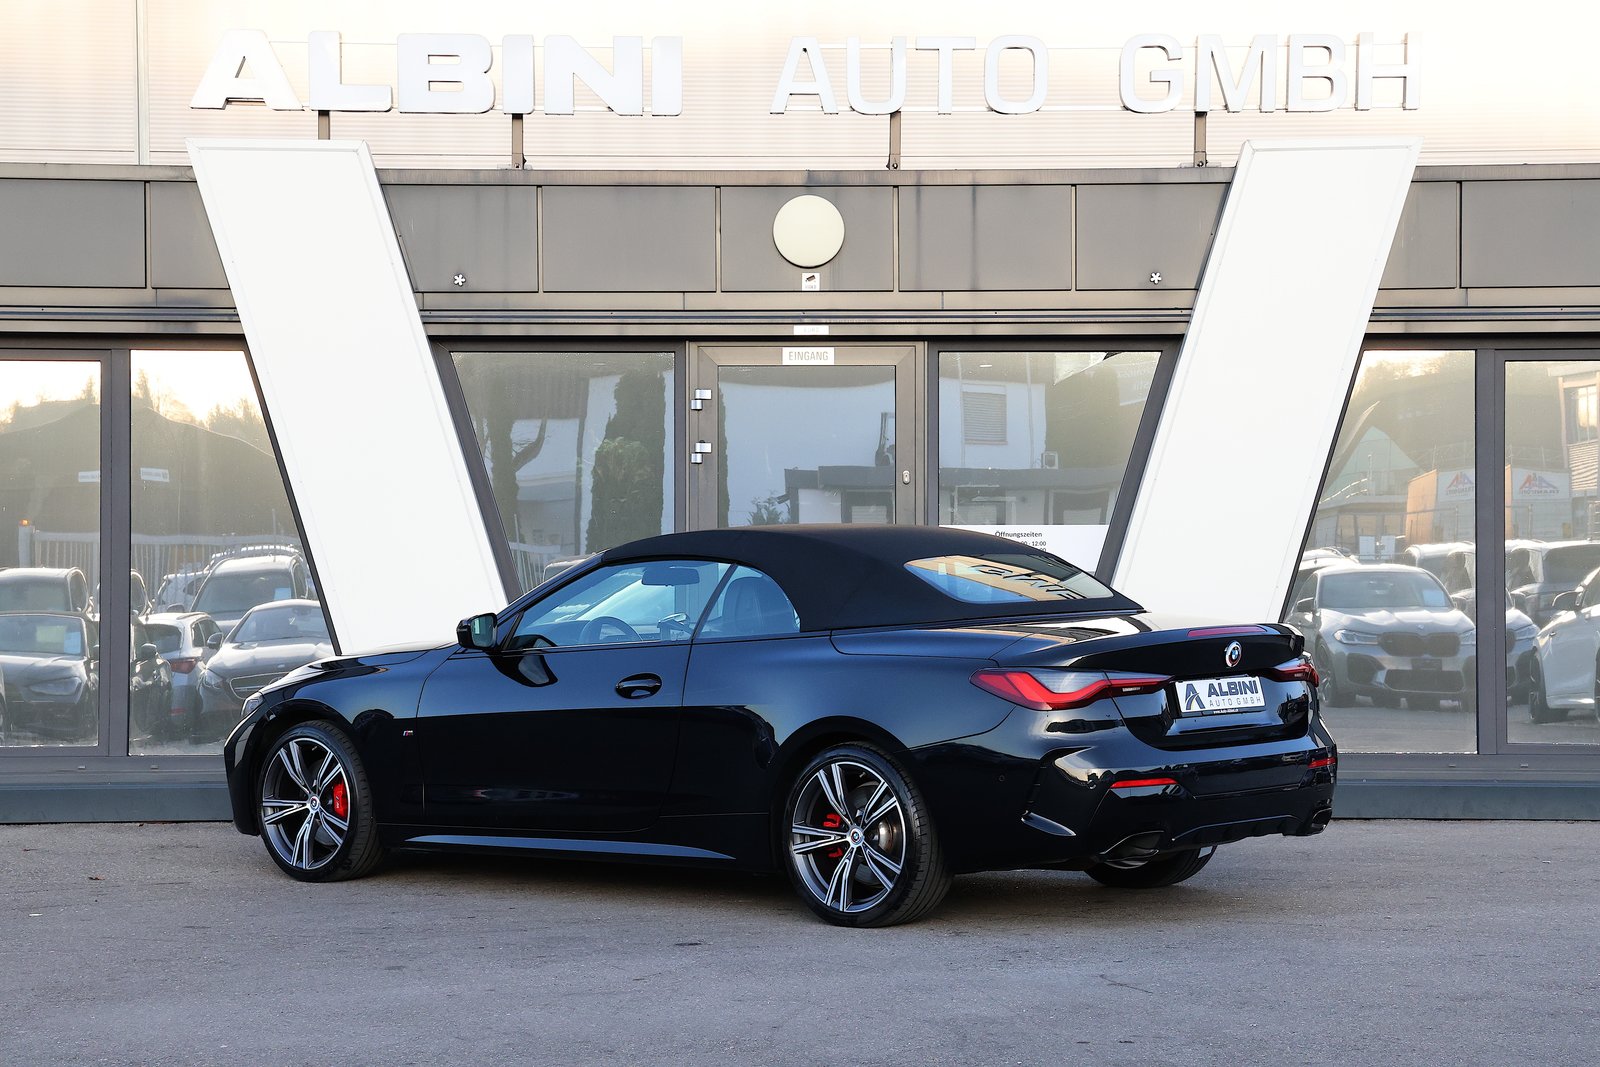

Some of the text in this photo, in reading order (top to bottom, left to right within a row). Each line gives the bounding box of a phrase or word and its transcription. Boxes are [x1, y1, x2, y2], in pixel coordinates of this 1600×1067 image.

[190, 29, 1421, 117] ALBINI AUTO GMBH
[788, 351, 829, 361] EINGANG
[994, 530, 1043, 538] Öffnungszeiten
[1207, 680, 1259, 698] ALBINI
[1209, 696, 1262, 707] AUTO GMBH
